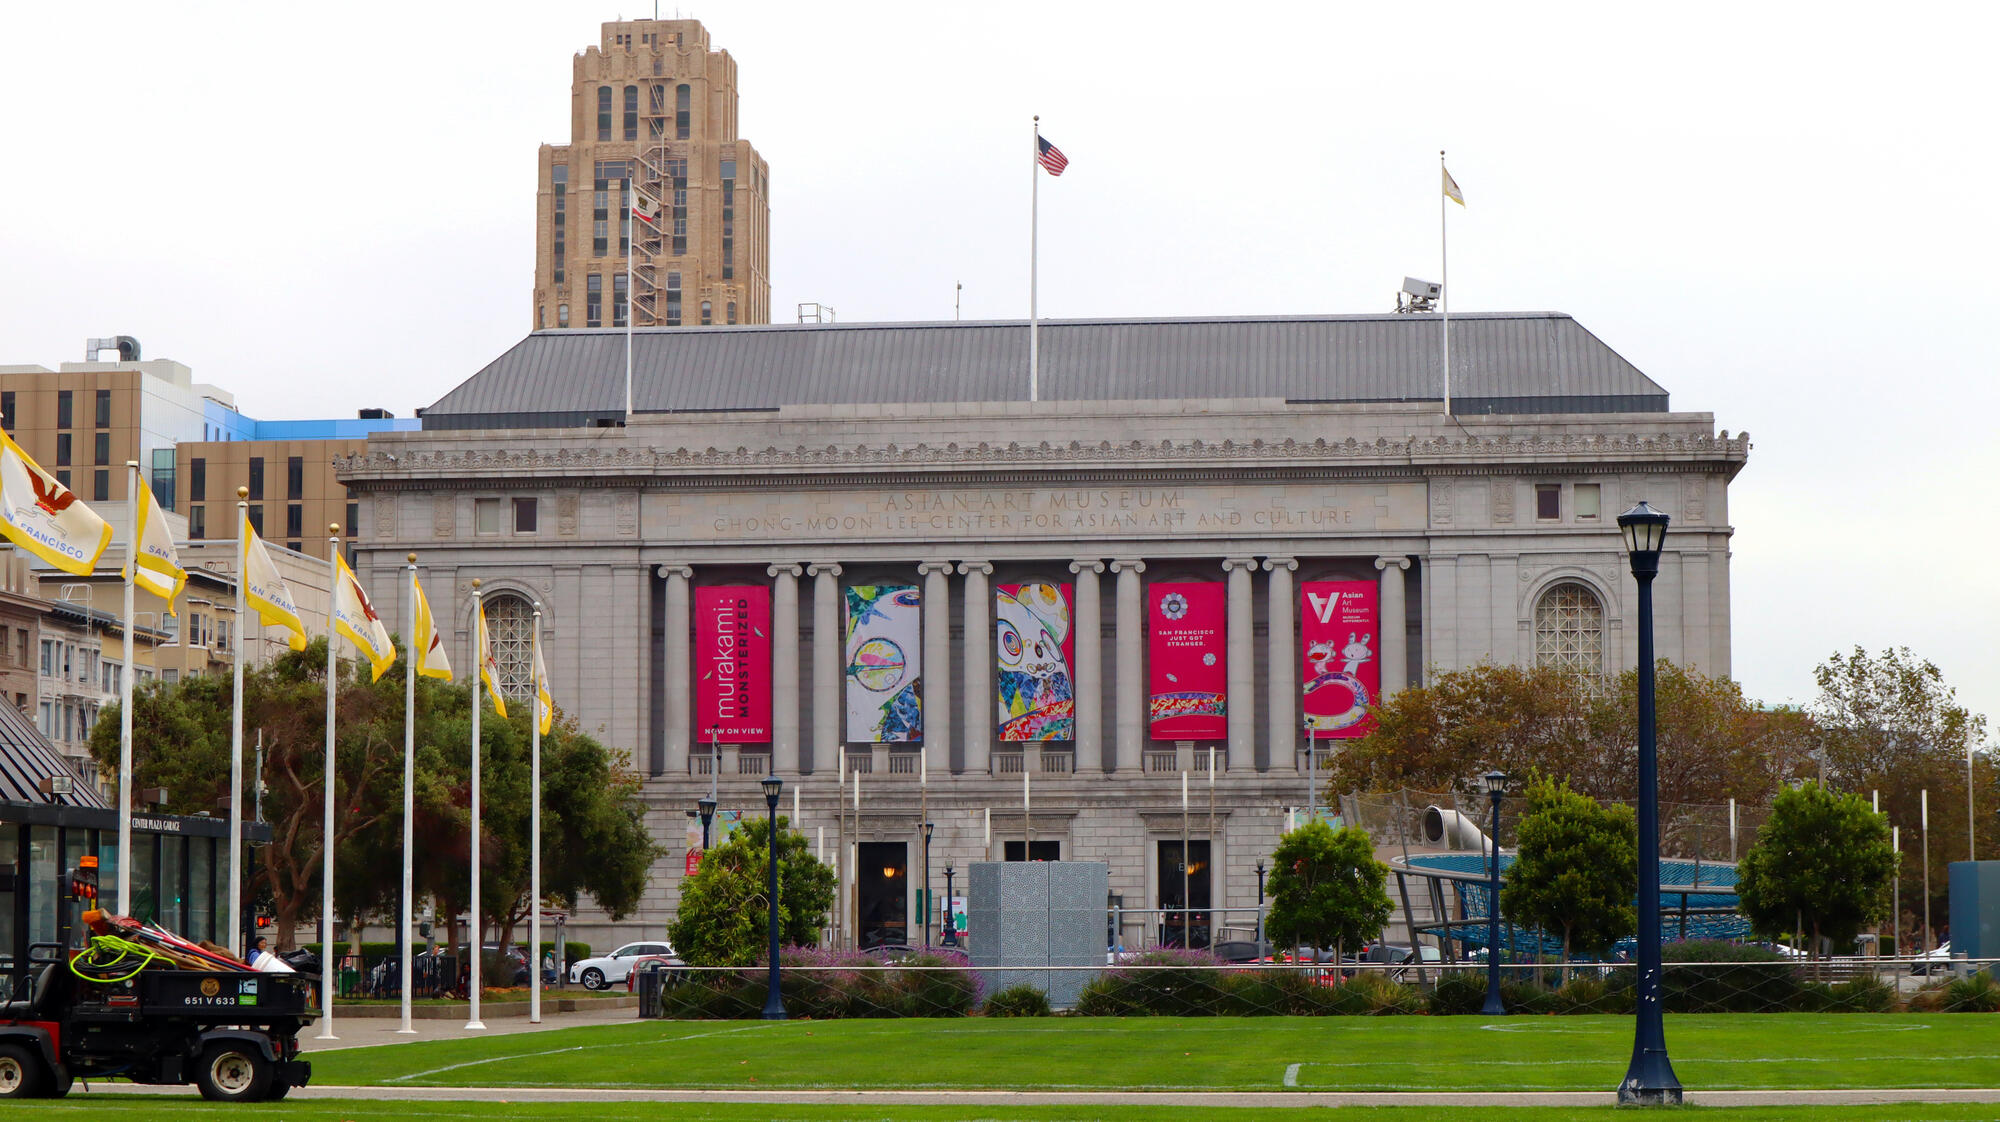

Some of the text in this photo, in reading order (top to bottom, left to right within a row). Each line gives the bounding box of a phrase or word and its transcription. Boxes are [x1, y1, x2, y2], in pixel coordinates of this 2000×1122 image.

[886, 491, 1179, 511] ASIAN ART MUSEUM
[713, 511, 1352, 531] CHONG-MOON LEE CENTER FOR ASIAN ART AND CULTURE
[21, 522, 84, 559] FRANCISCO
[149, 544, 169, 558] SAN
[713, 599, 735, 718] murakami:
[738, 598, 750, 718] MONSTERIZED
[184, 997, 203, 1005] 651
[206, 997, 213, 1005] V
[215, 997, 235, 1005] 633
